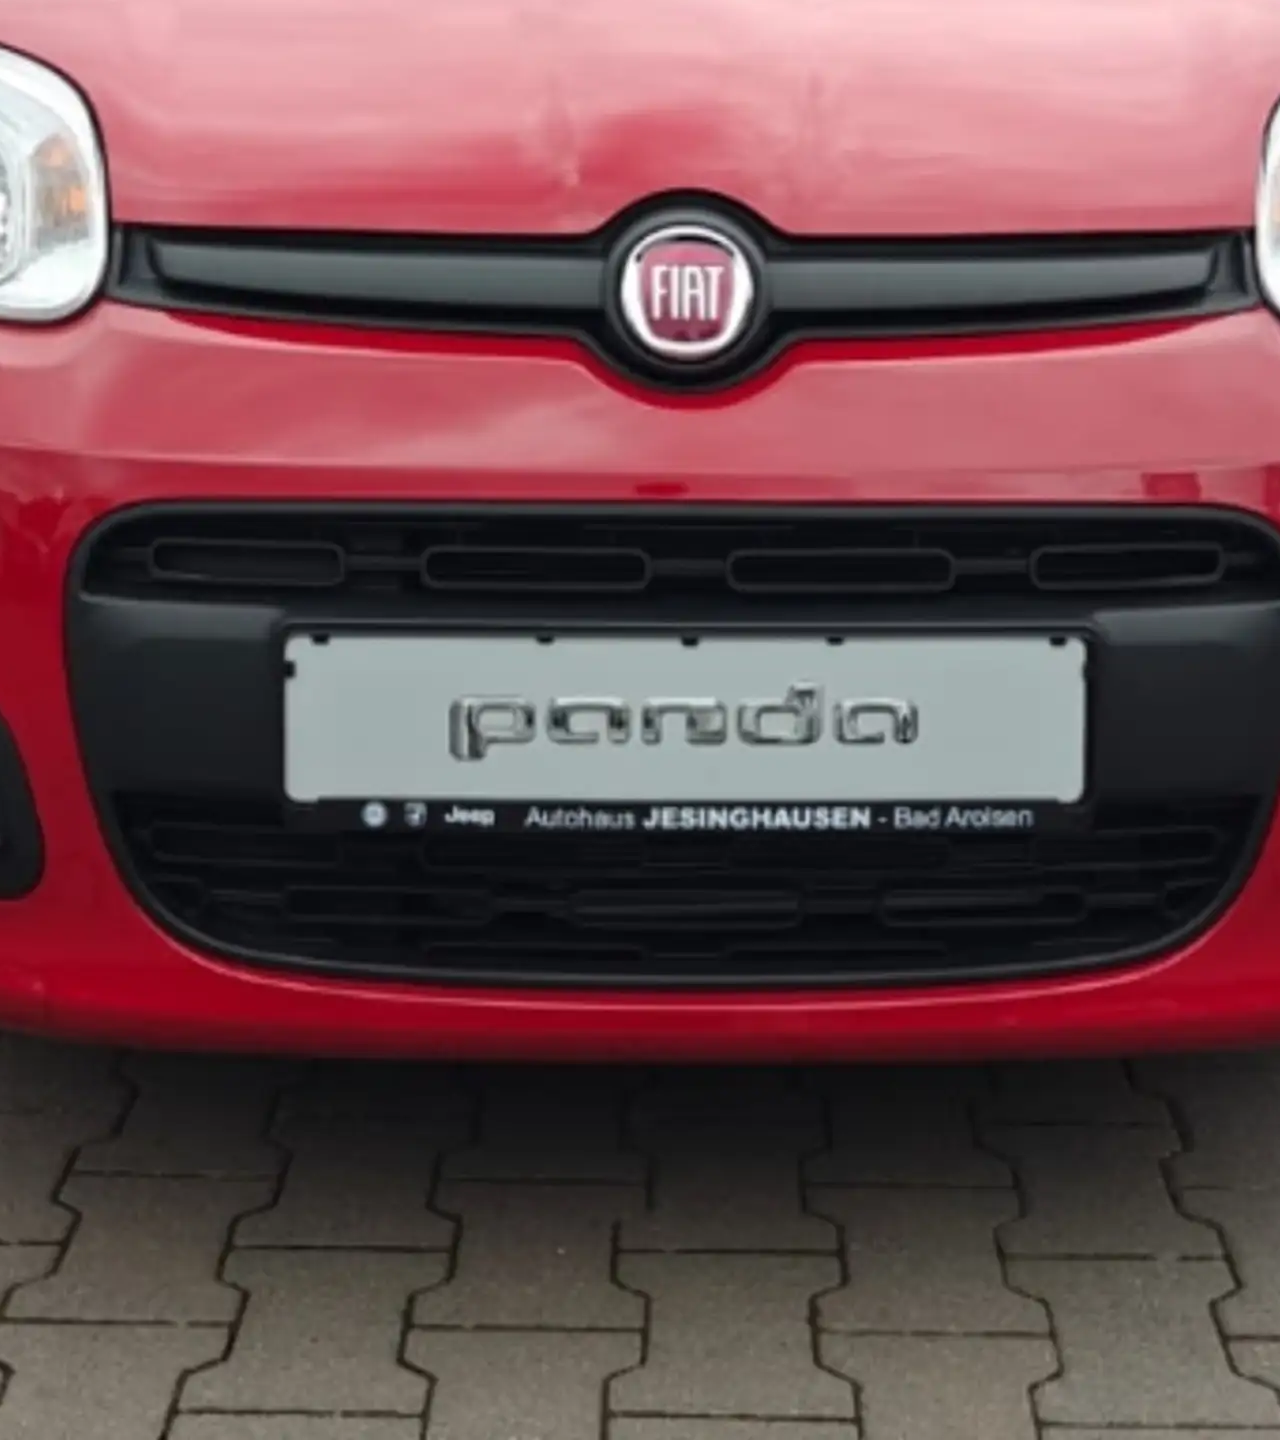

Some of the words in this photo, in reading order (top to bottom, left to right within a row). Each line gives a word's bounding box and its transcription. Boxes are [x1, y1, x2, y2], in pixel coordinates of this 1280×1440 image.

[650, 265, 725, 321] FIAT
[448, 678, 920, 762] panda
[444, 805, 496, 827] Jeep
[524, 806, 635, 830] Autohaus
[642, 806, 871, 830] JESINGHAUSEN
[893, 806, 940, 829] Bad
